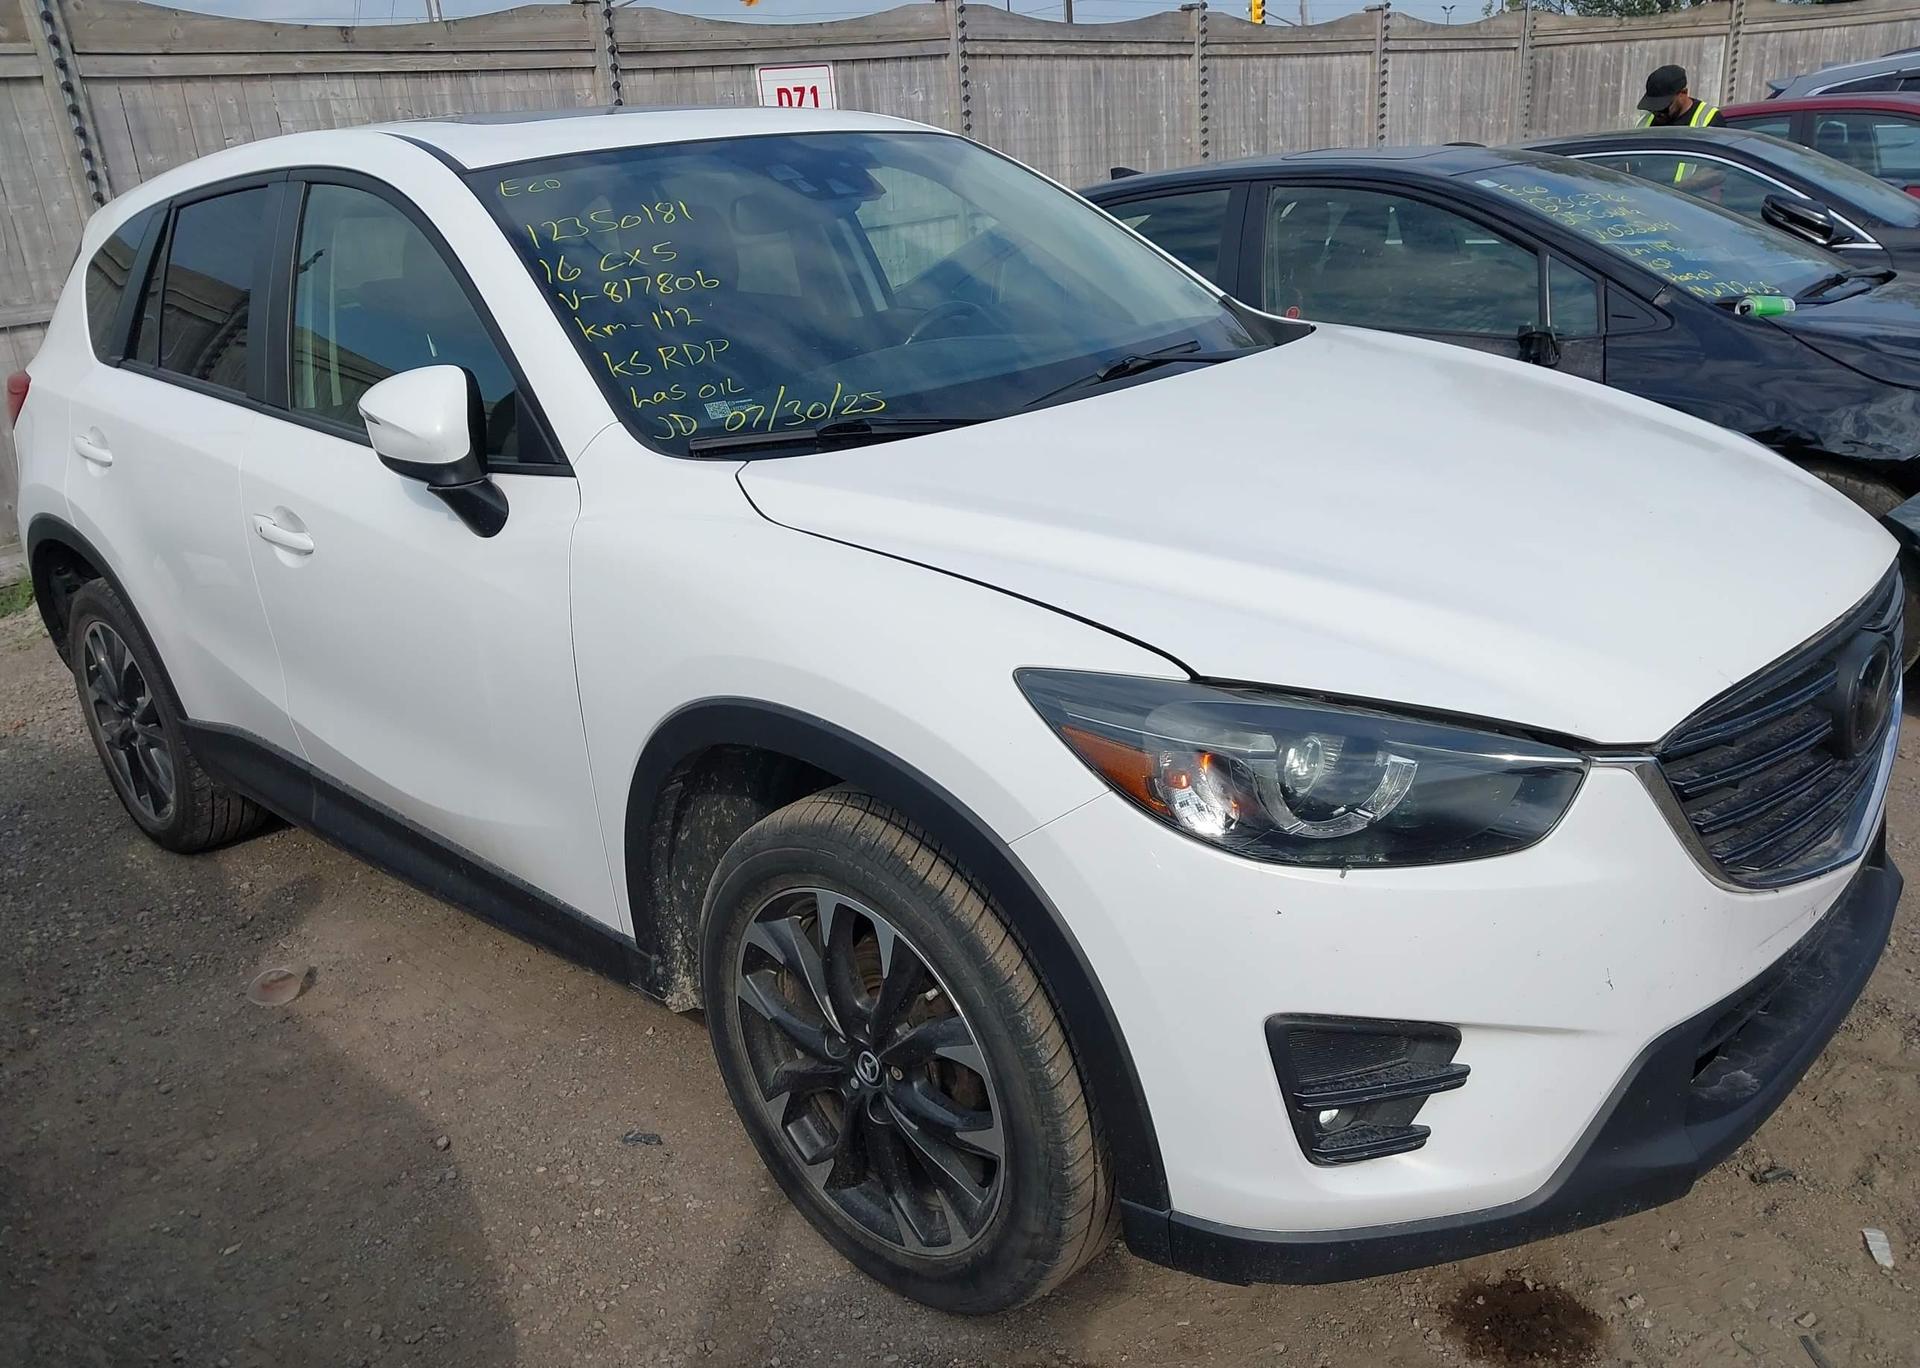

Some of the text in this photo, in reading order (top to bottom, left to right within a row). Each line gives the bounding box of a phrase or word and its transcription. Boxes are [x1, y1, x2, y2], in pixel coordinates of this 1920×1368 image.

[777, 85, 819, 108] D71
[526, 200, 694, 249] 12350181
[539, 255, 582, 284] 16
[657, 339, 730, 370] RDP
[654, 382, 887, 440] JD 07/30/25
